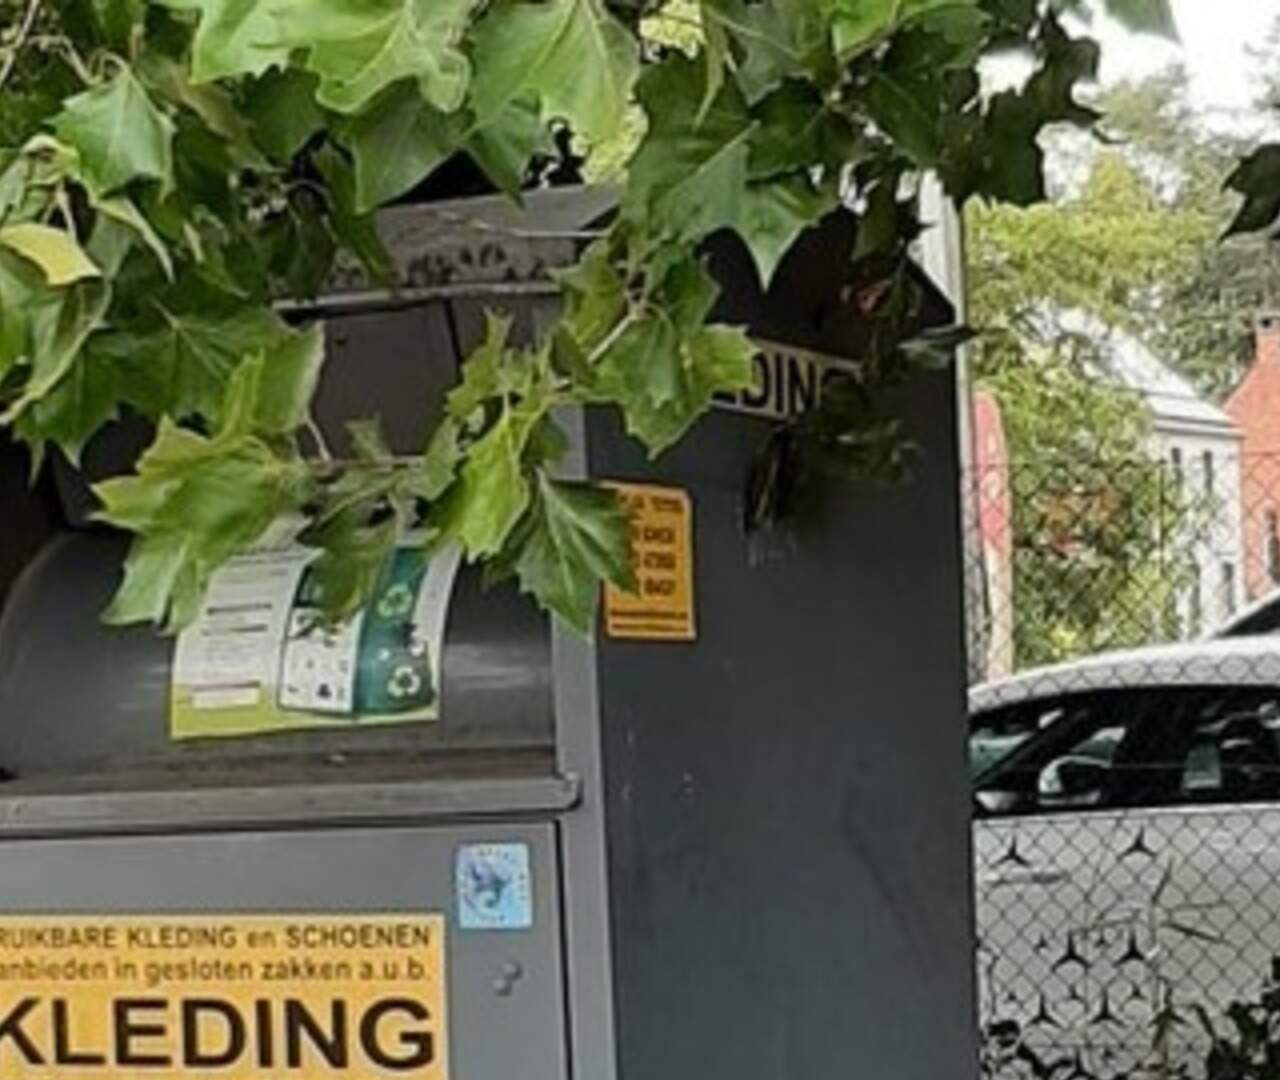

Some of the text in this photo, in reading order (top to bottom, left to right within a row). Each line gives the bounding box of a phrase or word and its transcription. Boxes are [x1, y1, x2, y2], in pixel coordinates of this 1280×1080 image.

[126, 926, 238, 950] KLEDING
[247, 930, 277, 949] en
[285, 924, 430, 949] SCHOENEN
[114, 955, 137, 981] in
[144, 956, 254, 989] gesloten
[260, 956, 353, 981] zakken
